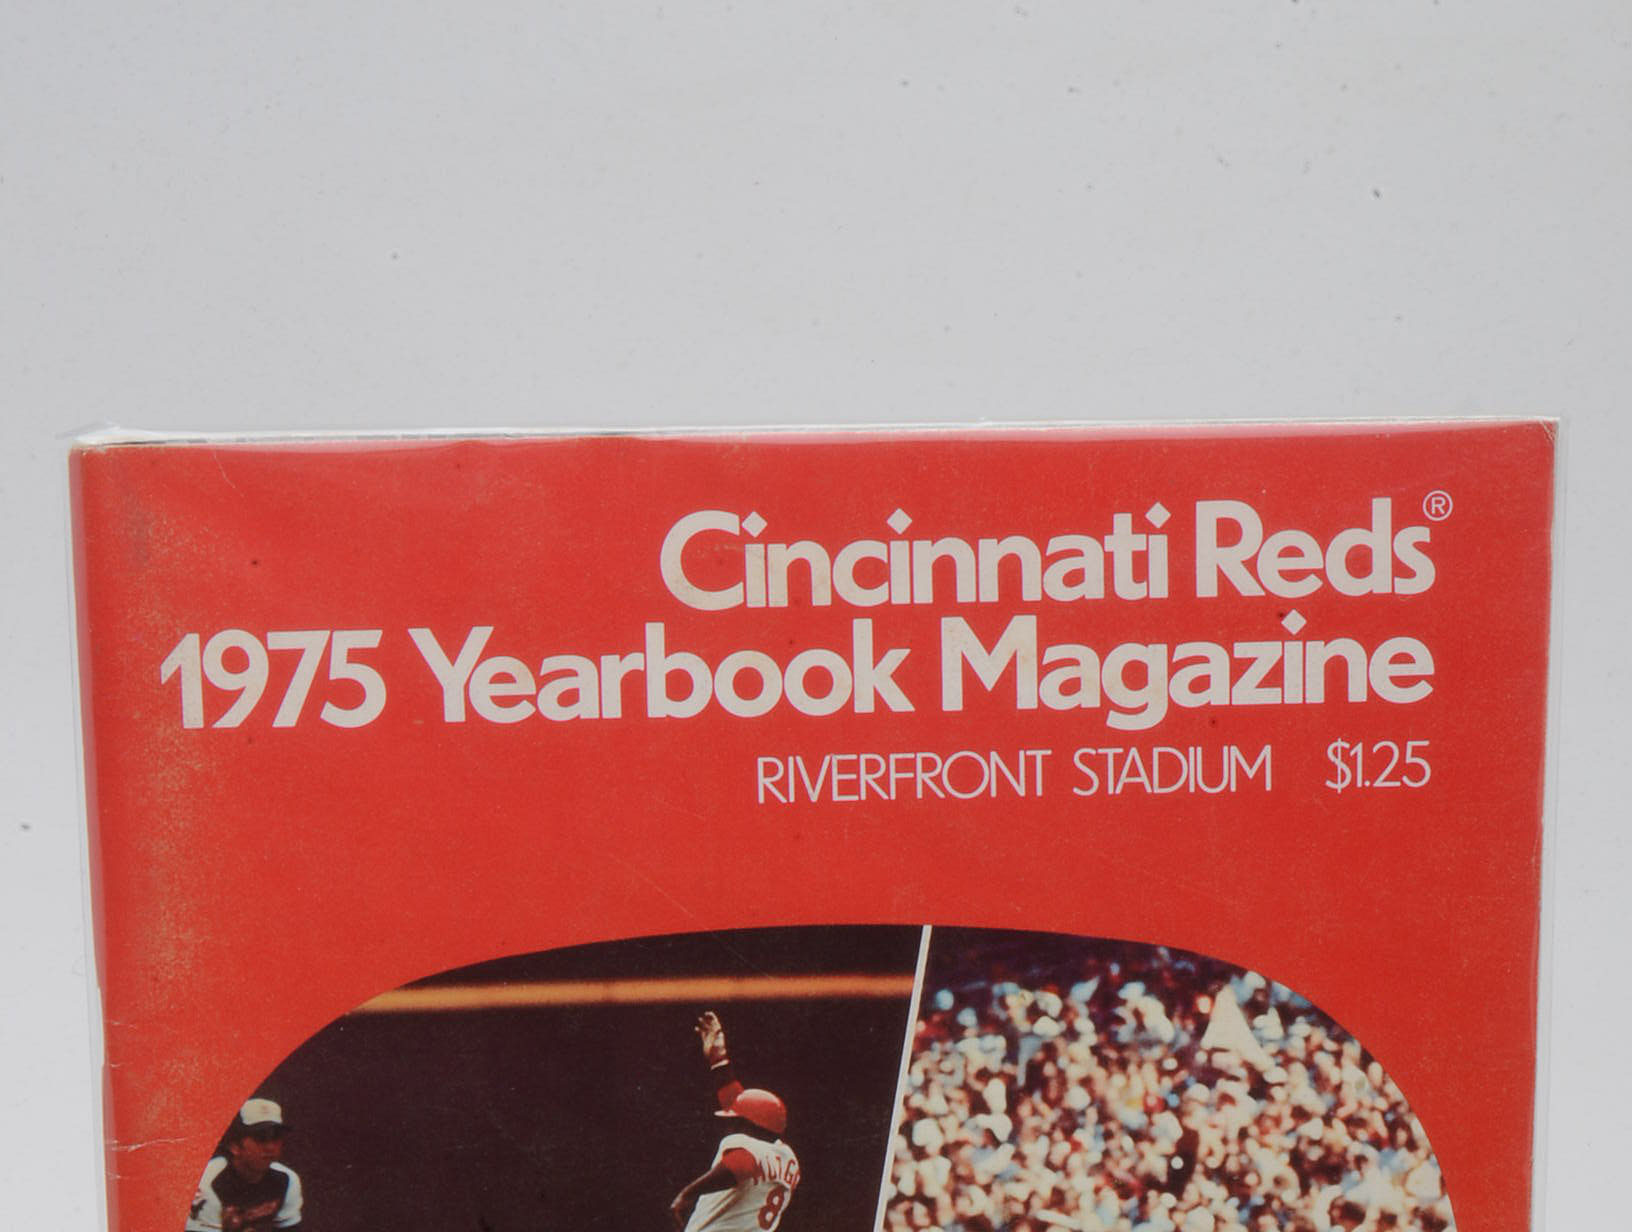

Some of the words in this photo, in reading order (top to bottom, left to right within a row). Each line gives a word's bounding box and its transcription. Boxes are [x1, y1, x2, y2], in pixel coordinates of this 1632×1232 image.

[661, 502, 1170, 611] Cincinnati
[160, 628, 387, 729] 1975
[408, 618, 916, 723] Yearbook
[940, 609, 1435, 731] Magazine
[757, 749, 1052, 804] RIVERFRONT
[1073, 744, 1272, 796] STADIUM
[1325, 738, 1432, 793] $1.25
[758, 1184, 785, 1231] 8
